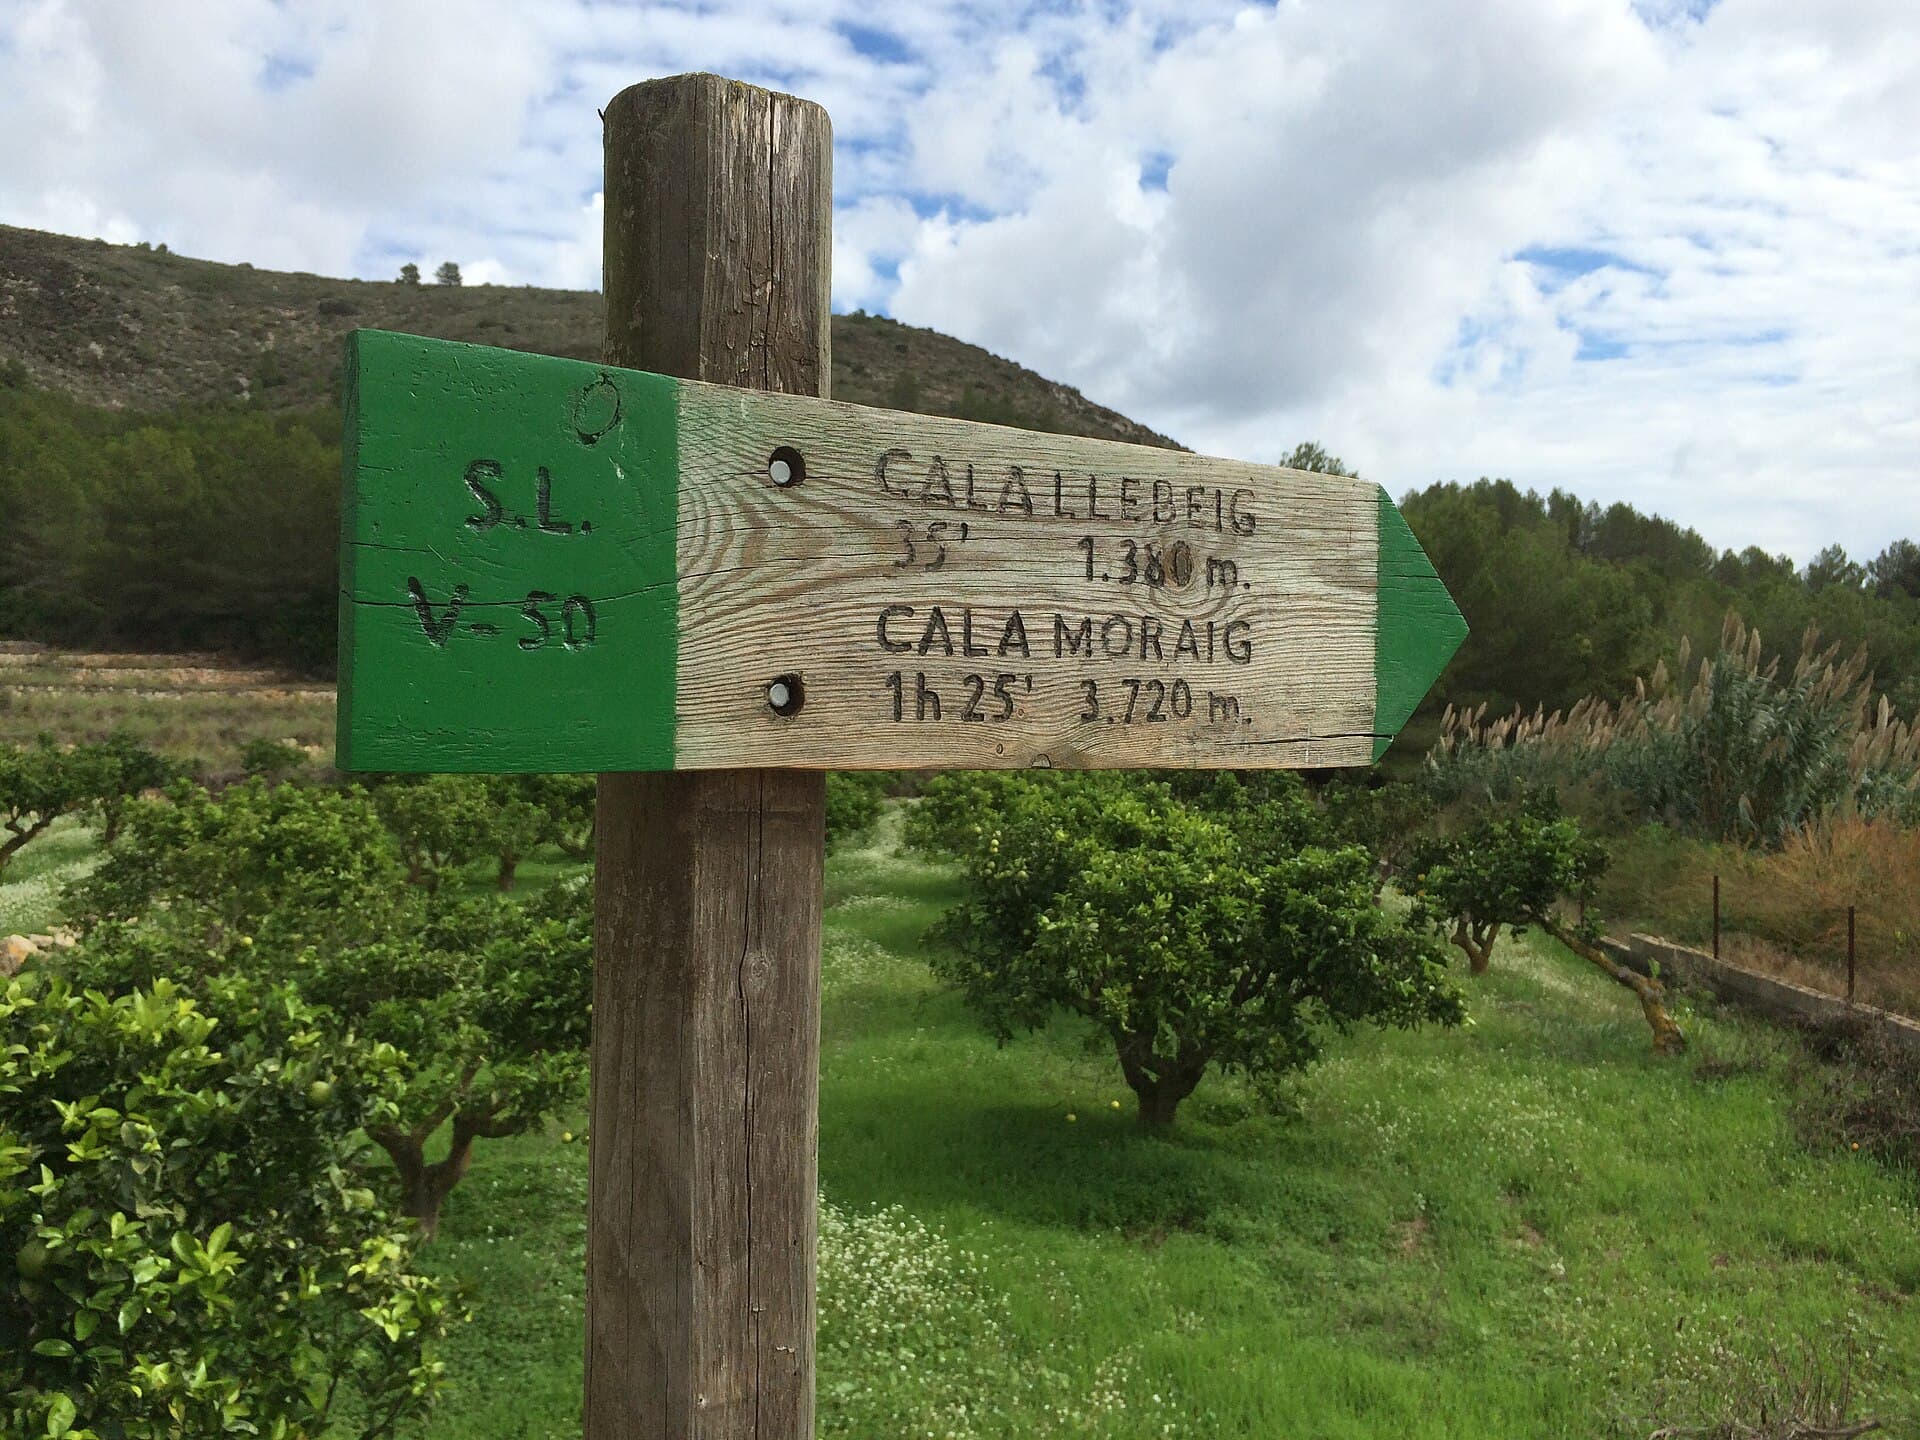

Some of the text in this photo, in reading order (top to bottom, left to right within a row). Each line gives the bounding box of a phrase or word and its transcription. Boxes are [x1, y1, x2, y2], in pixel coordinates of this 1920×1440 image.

[464, 459, 592, 535] S.L.
[873, 447, 1033, 518] CALA
[1206, 556, 1251, 590] m.
[876, 604, 1252, 665] CALA MORAIG
[960, 673, 1033, 723] 25'
[1079, 677, 1193, 724] 3.720
[1207, 690, 1252, 726] m.
